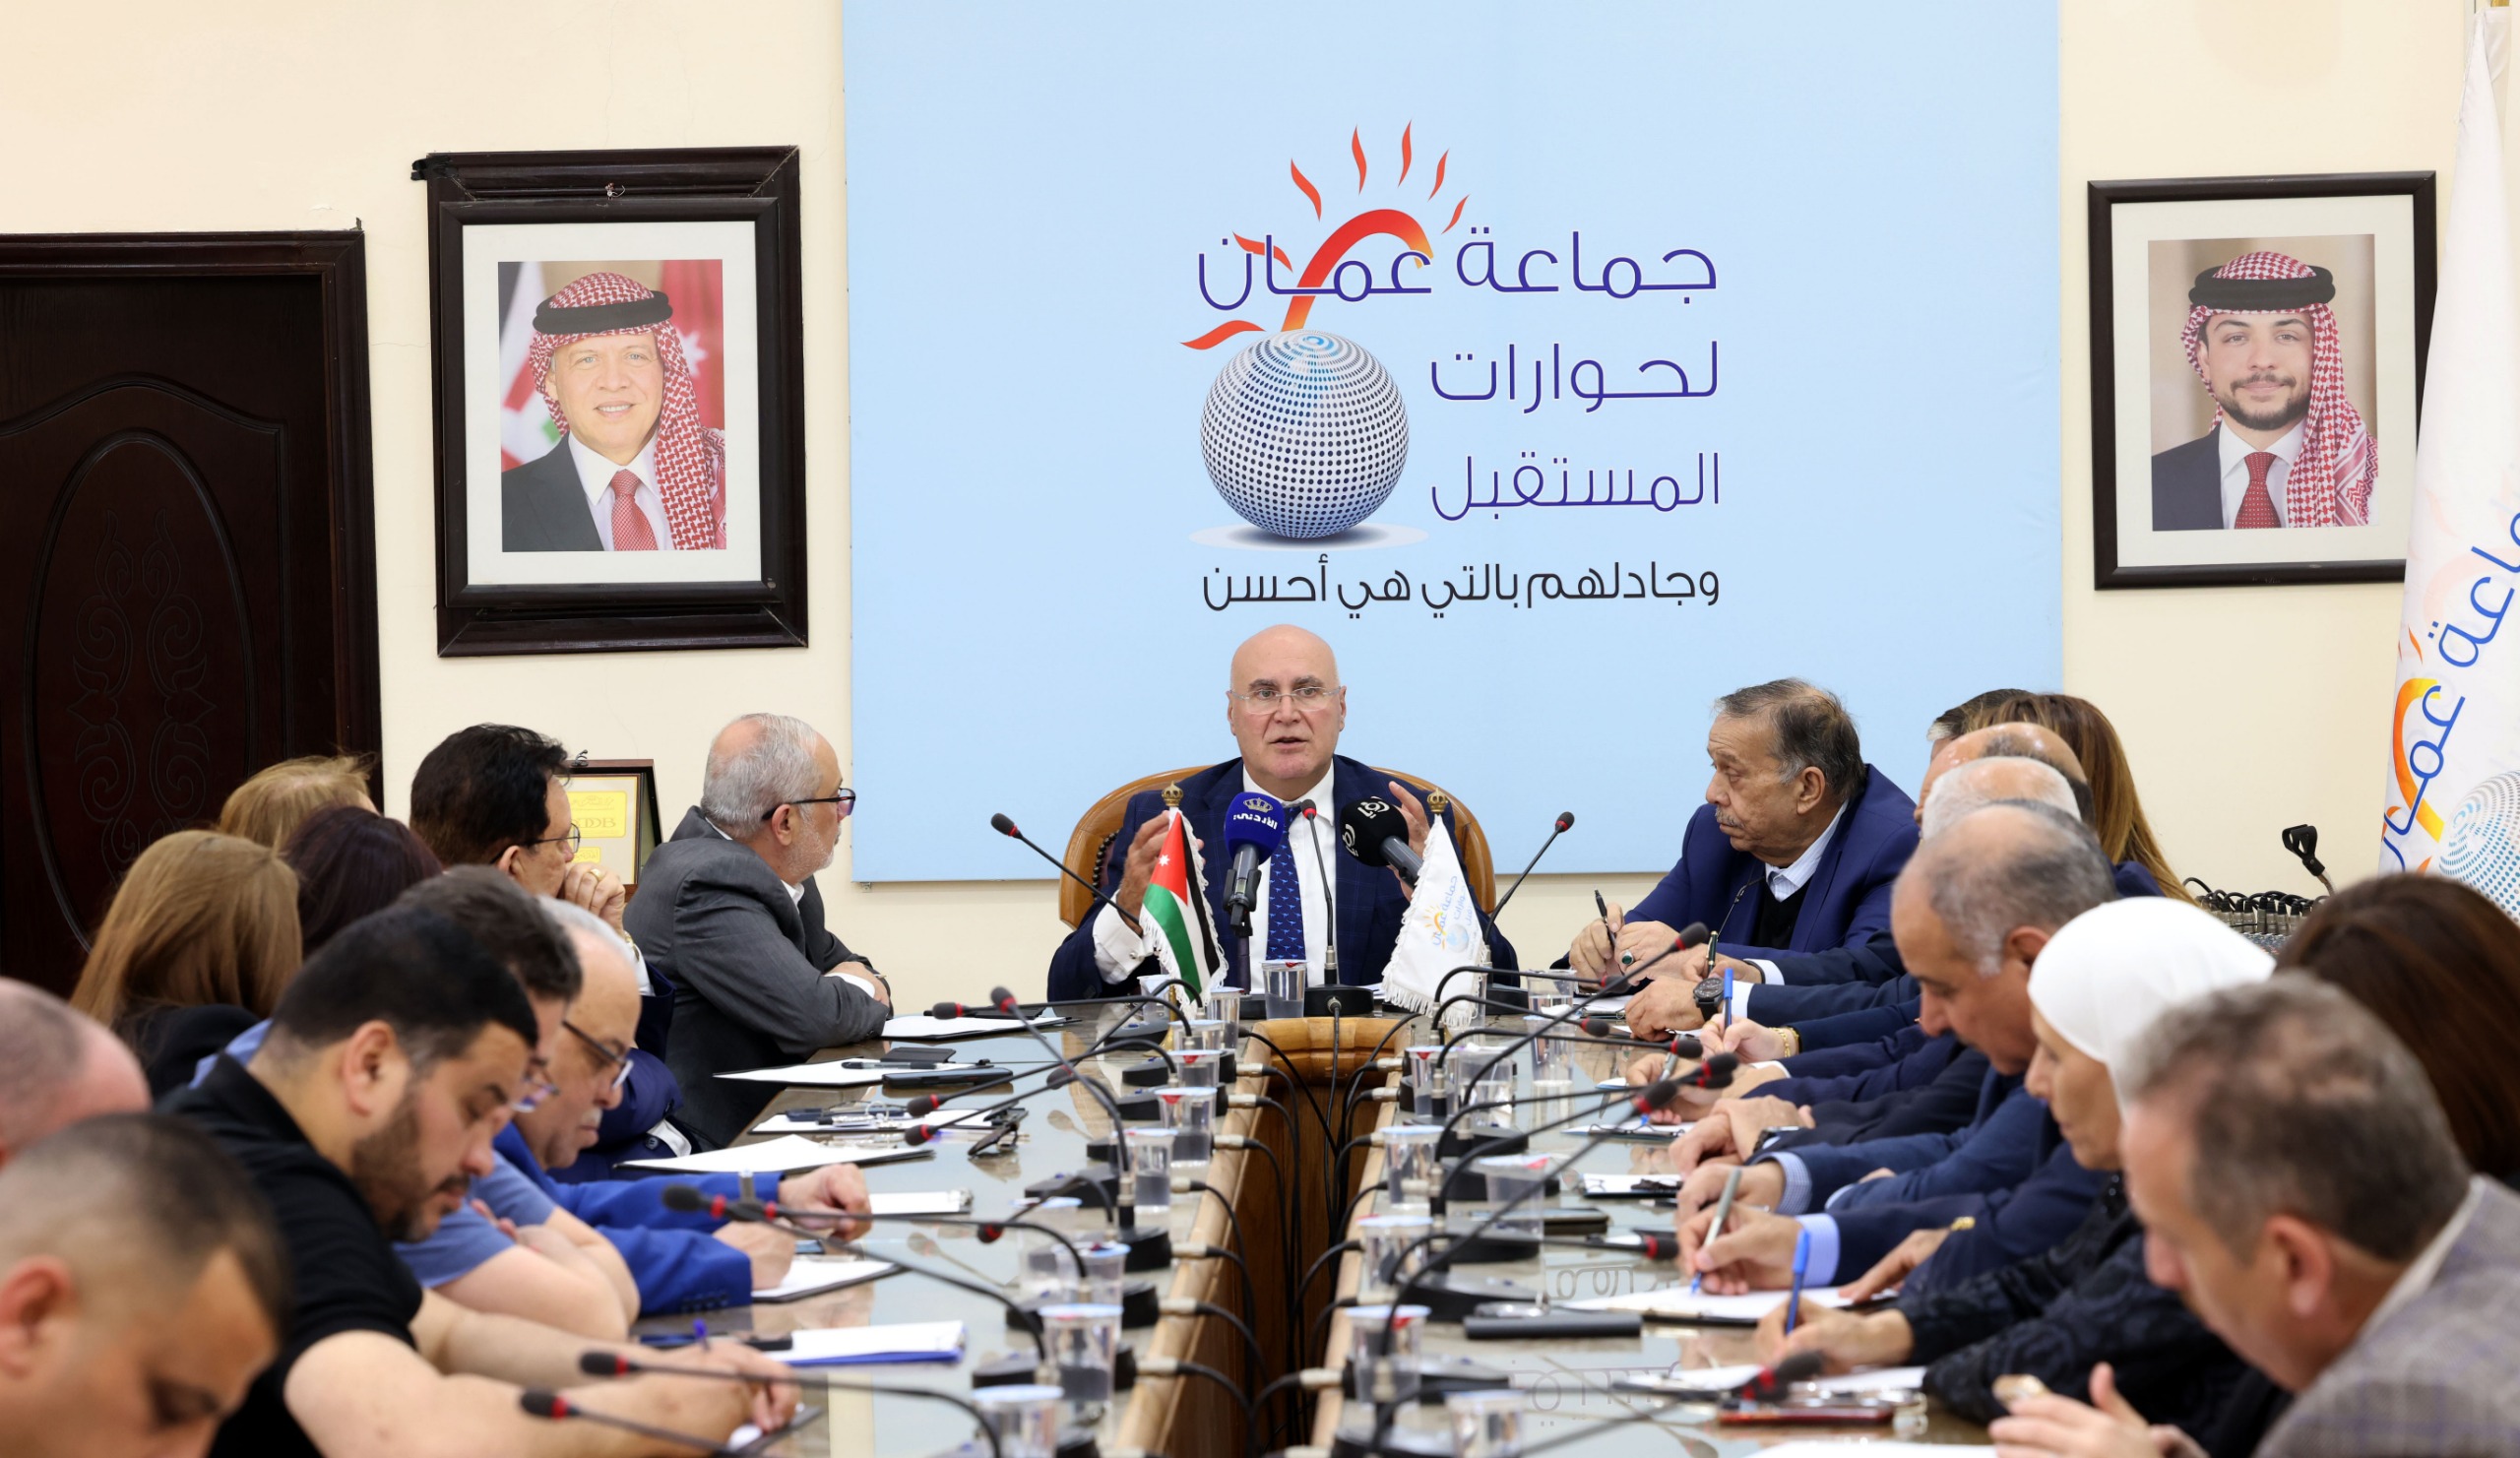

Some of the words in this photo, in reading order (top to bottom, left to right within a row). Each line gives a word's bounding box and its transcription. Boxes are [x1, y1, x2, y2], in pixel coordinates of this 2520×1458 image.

[1198, 234, 1432, 311] عمان
[1456, 226, 1717, 304] جماعة
[1431, 341, 1718, 414] لحوارات
[1431, 451, 1719, 522] المستقبل
[1203, 553, 1329, 611] أحسن
[1337, 569, 1411, 619] هي
[1421, 563, 1519, 619] بالتي
[1527, 561, 1720, 606] وجادلهم
